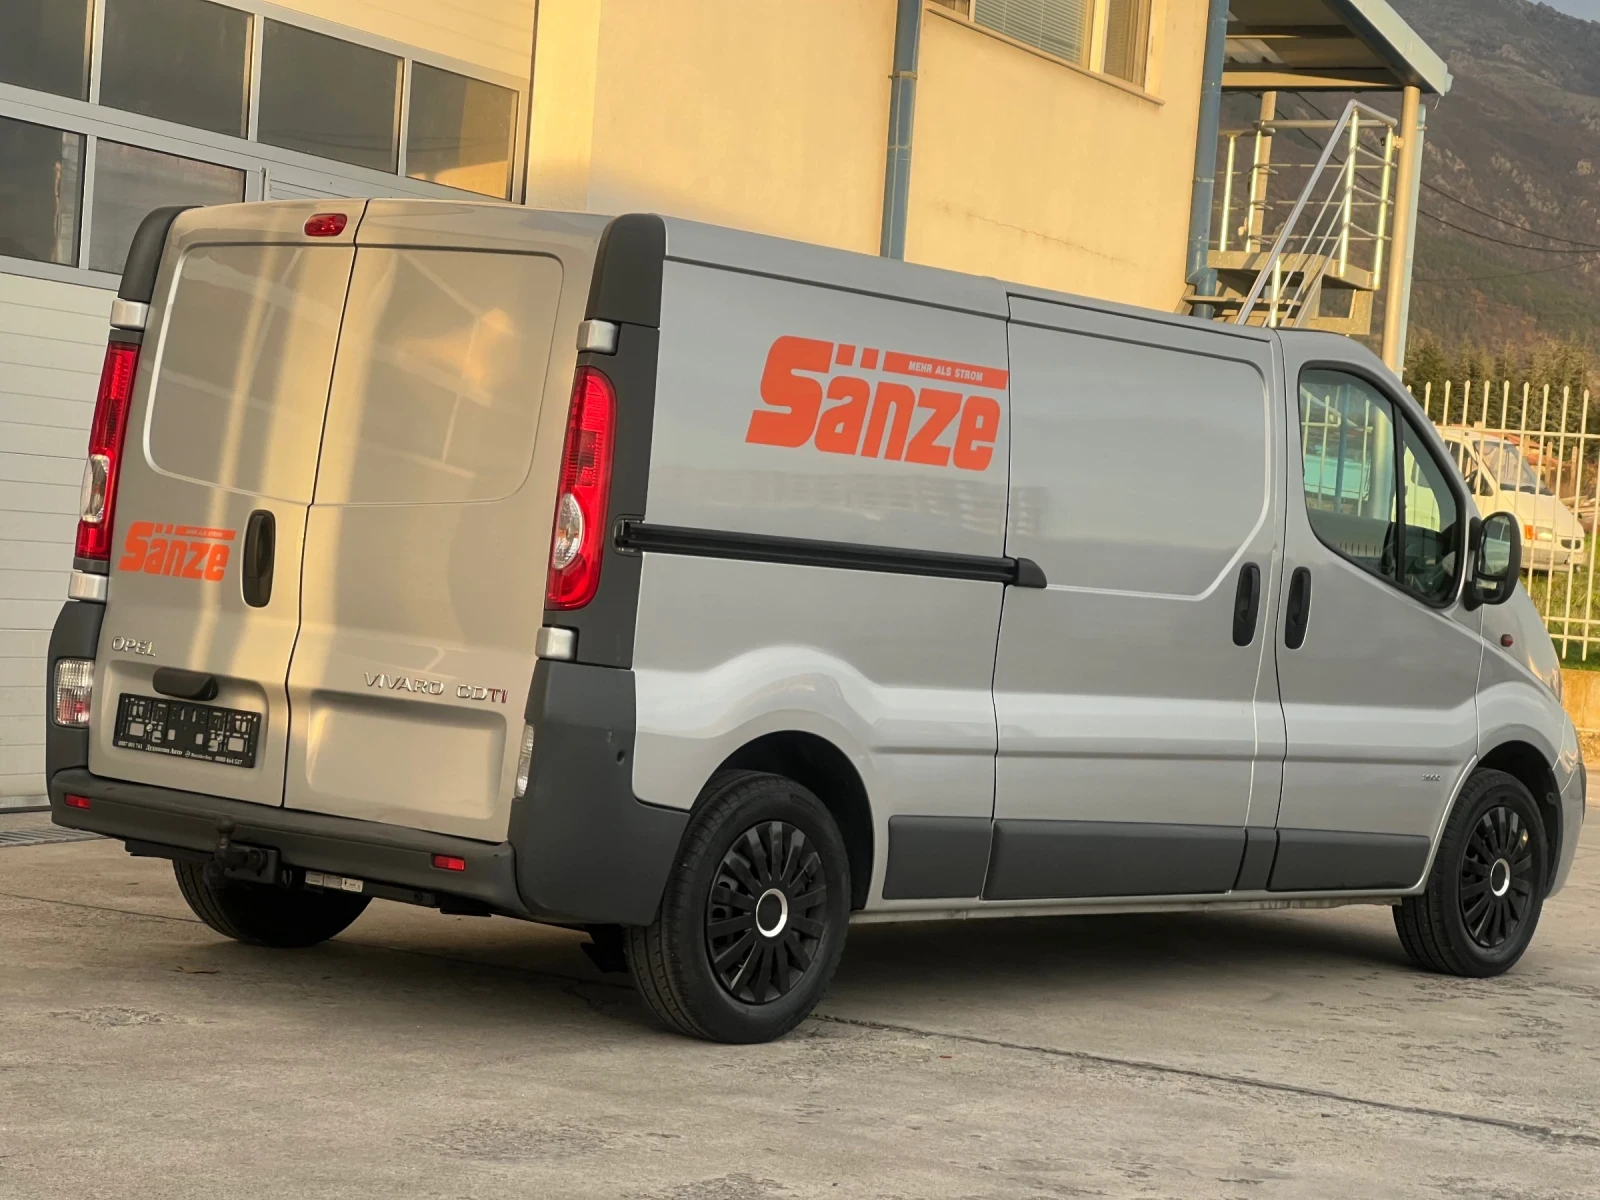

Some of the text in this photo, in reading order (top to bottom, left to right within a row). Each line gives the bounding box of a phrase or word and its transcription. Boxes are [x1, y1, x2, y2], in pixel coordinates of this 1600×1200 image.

[908, 360, 984, 382] MEHR ALS STROM
[745, 335, 1001, 472] Sänze
[117, 521, 231, 582] Sänze
[111, 635, 156, 657] OPEL
[364, 672, 508, 704] VIVARO CDTI
